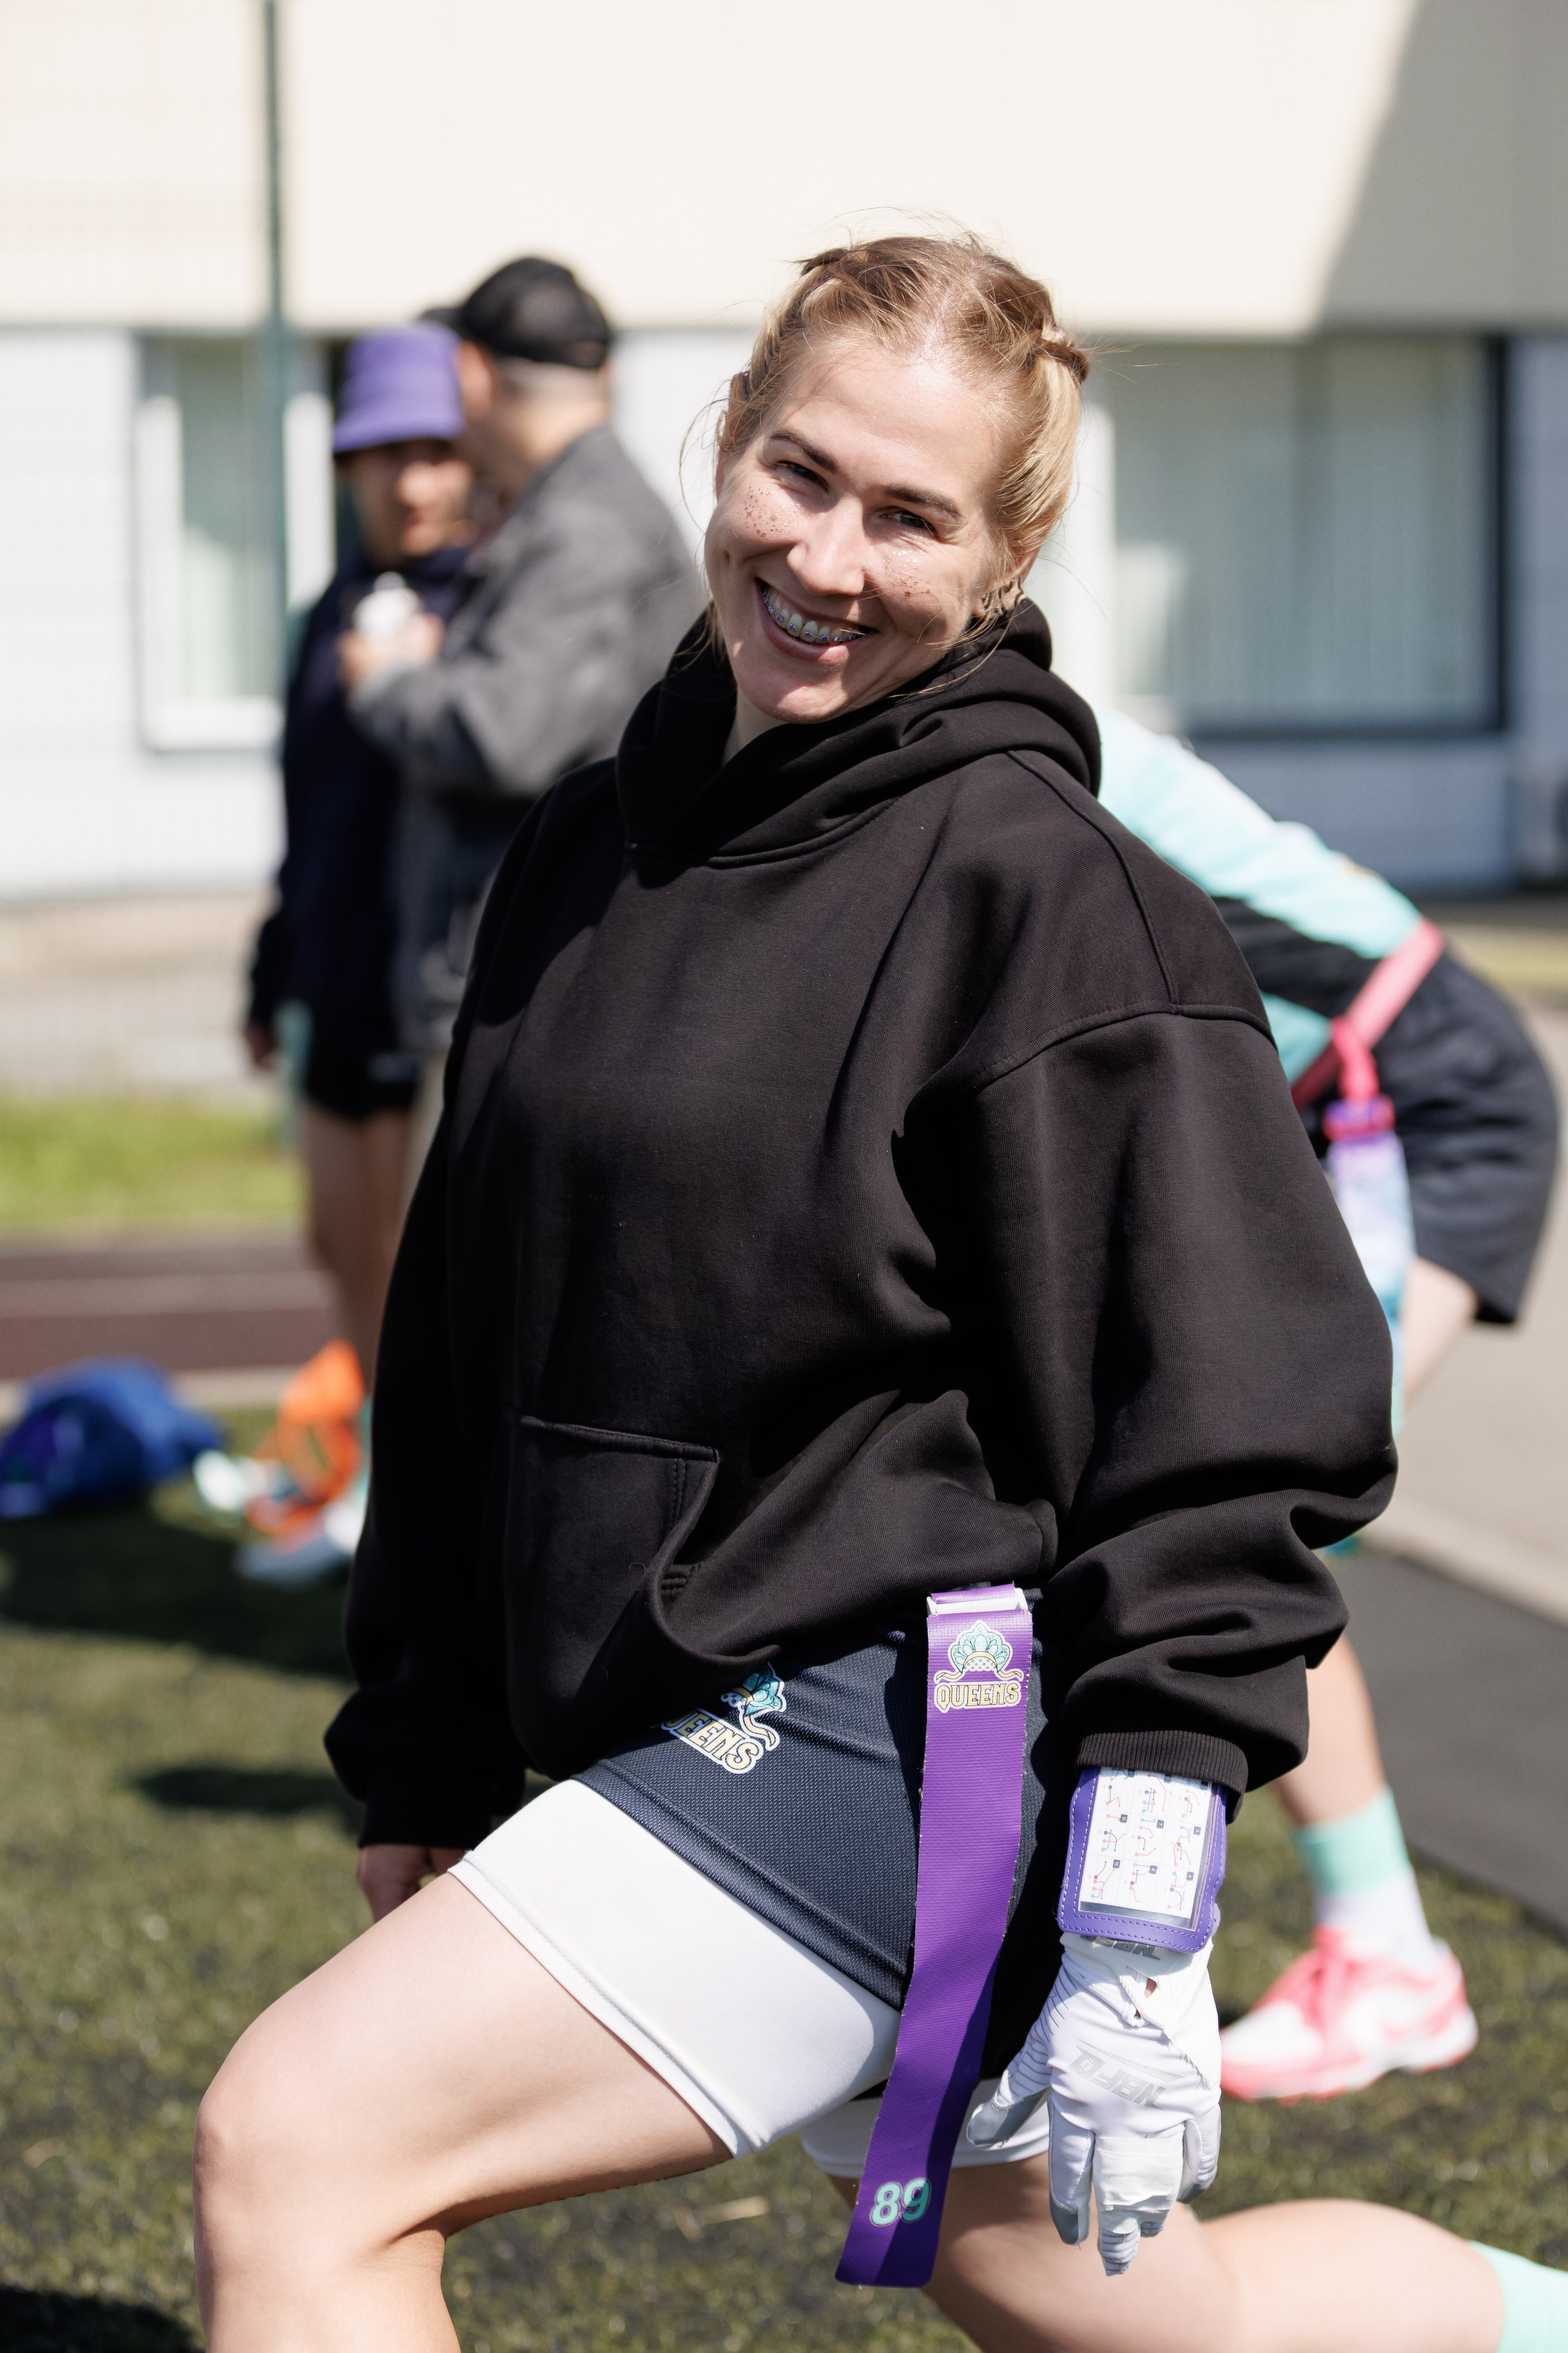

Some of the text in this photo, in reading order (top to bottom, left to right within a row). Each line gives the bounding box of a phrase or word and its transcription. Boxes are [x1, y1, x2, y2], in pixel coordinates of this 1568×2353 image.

[936, 1682, 1019, 1710] QUEENS
[664, 1710, 760, 1770] UEENS
[870, 2178, 930, 2226] 89
